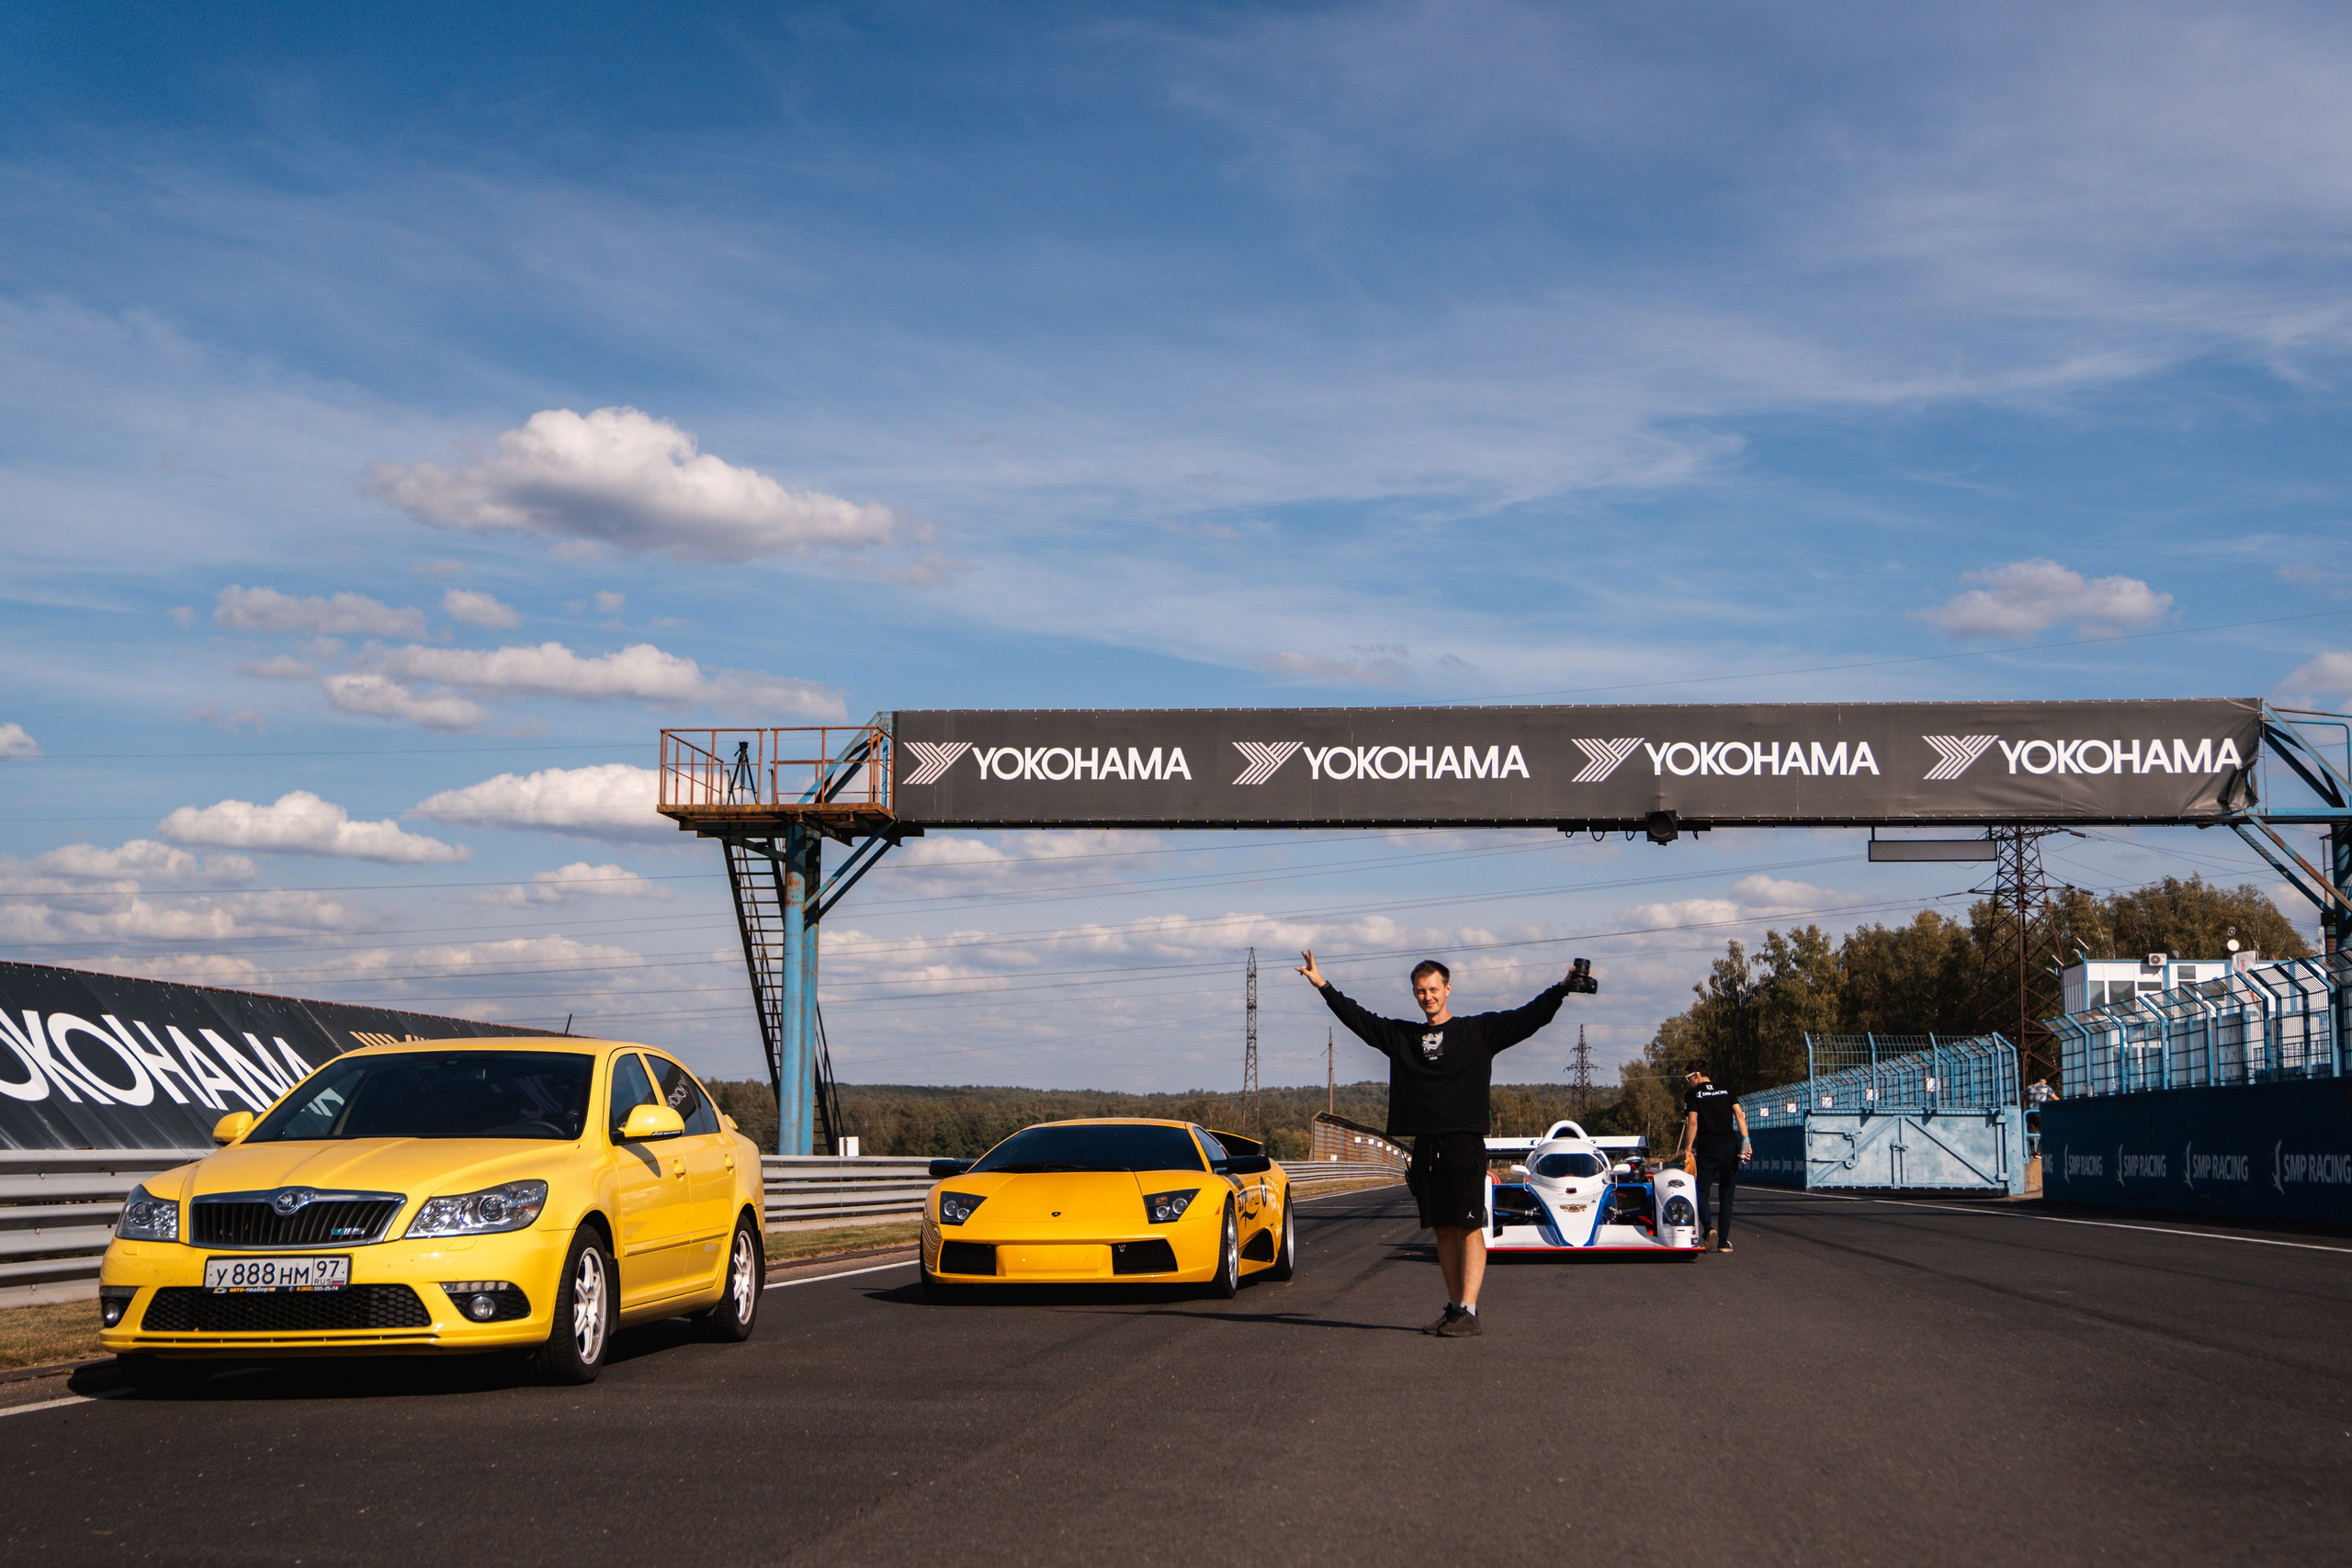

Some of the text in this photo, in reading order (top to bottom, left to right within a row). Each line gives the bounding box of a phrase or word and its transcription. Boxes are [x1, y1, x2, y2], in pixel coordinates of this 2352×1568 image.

[971, 747, 1193, 780] YOKOHAMA
[1302, 745, 1531, 780] YOKOHAMA
[1644, 741, 1880, 776] YOKOHAMA
[1997, 739, 2243, 774] YOKOHAMA
[2068, 1154, 2102, 1176] SMP RACING
[2123, 1154, 2166, 1178] SMP RACING
[2192, 1154, 2248, 1181] SMP RACING
[2283, 1154, 2352, 1184] SMP RACING
[316, 1260, 340, 1278] 97
